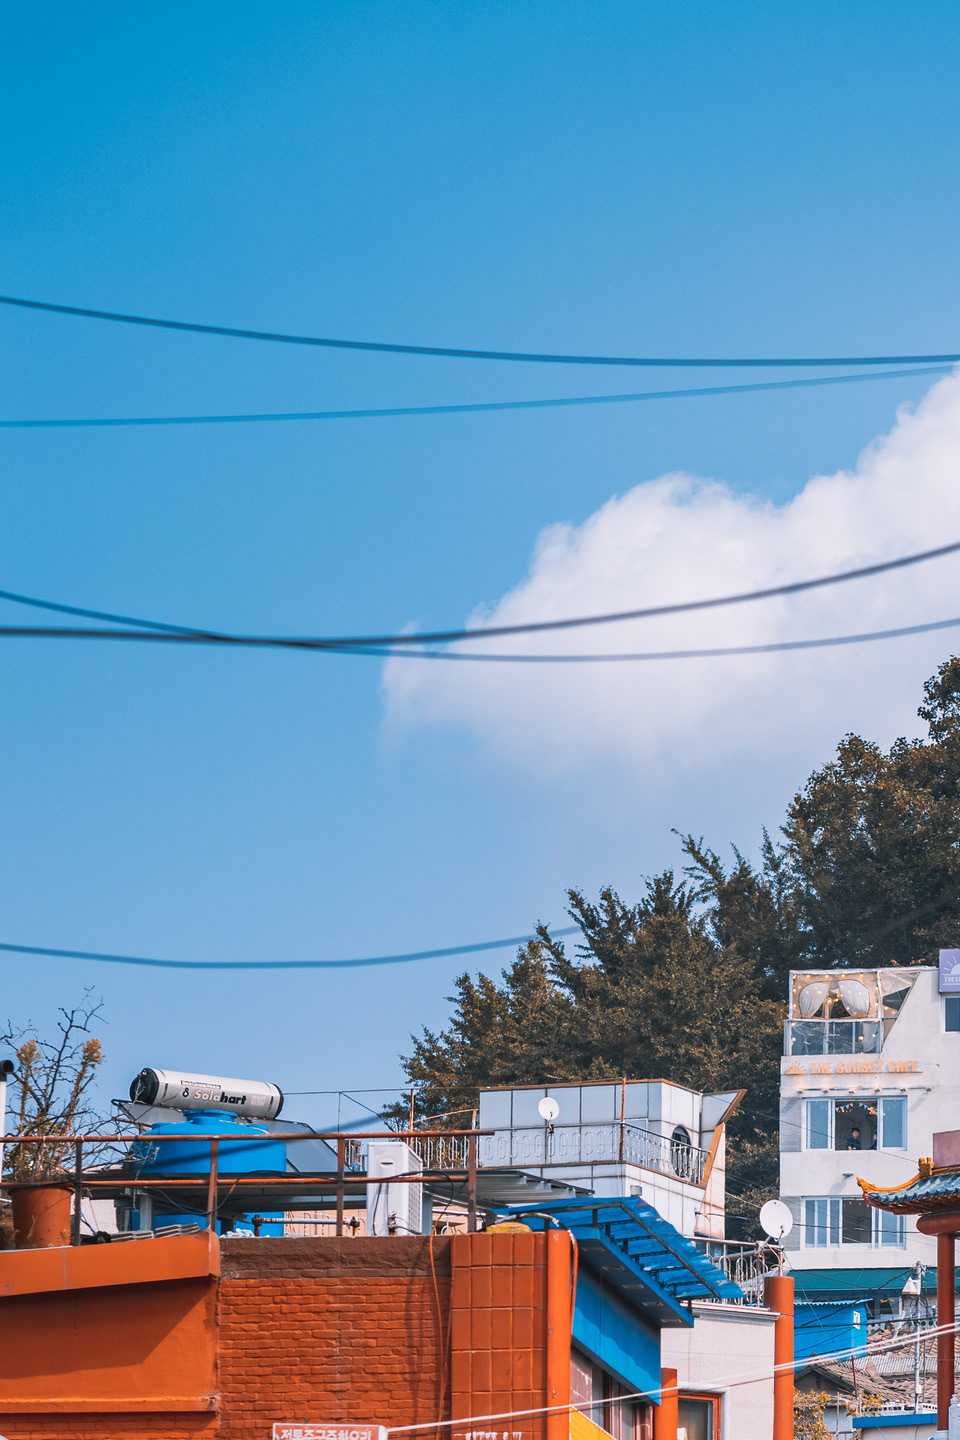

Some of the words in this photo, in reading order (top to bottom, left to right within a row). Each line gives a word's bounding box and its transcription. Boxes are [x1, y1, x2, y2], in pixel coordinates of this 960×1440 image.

[810, 1062, 832, 1074] THE
[837, 1061, 884, 1074] SUNSET
[888, 1060, 918, 1073] CAFE
[193, 1089, 247, 1105] Solahart
